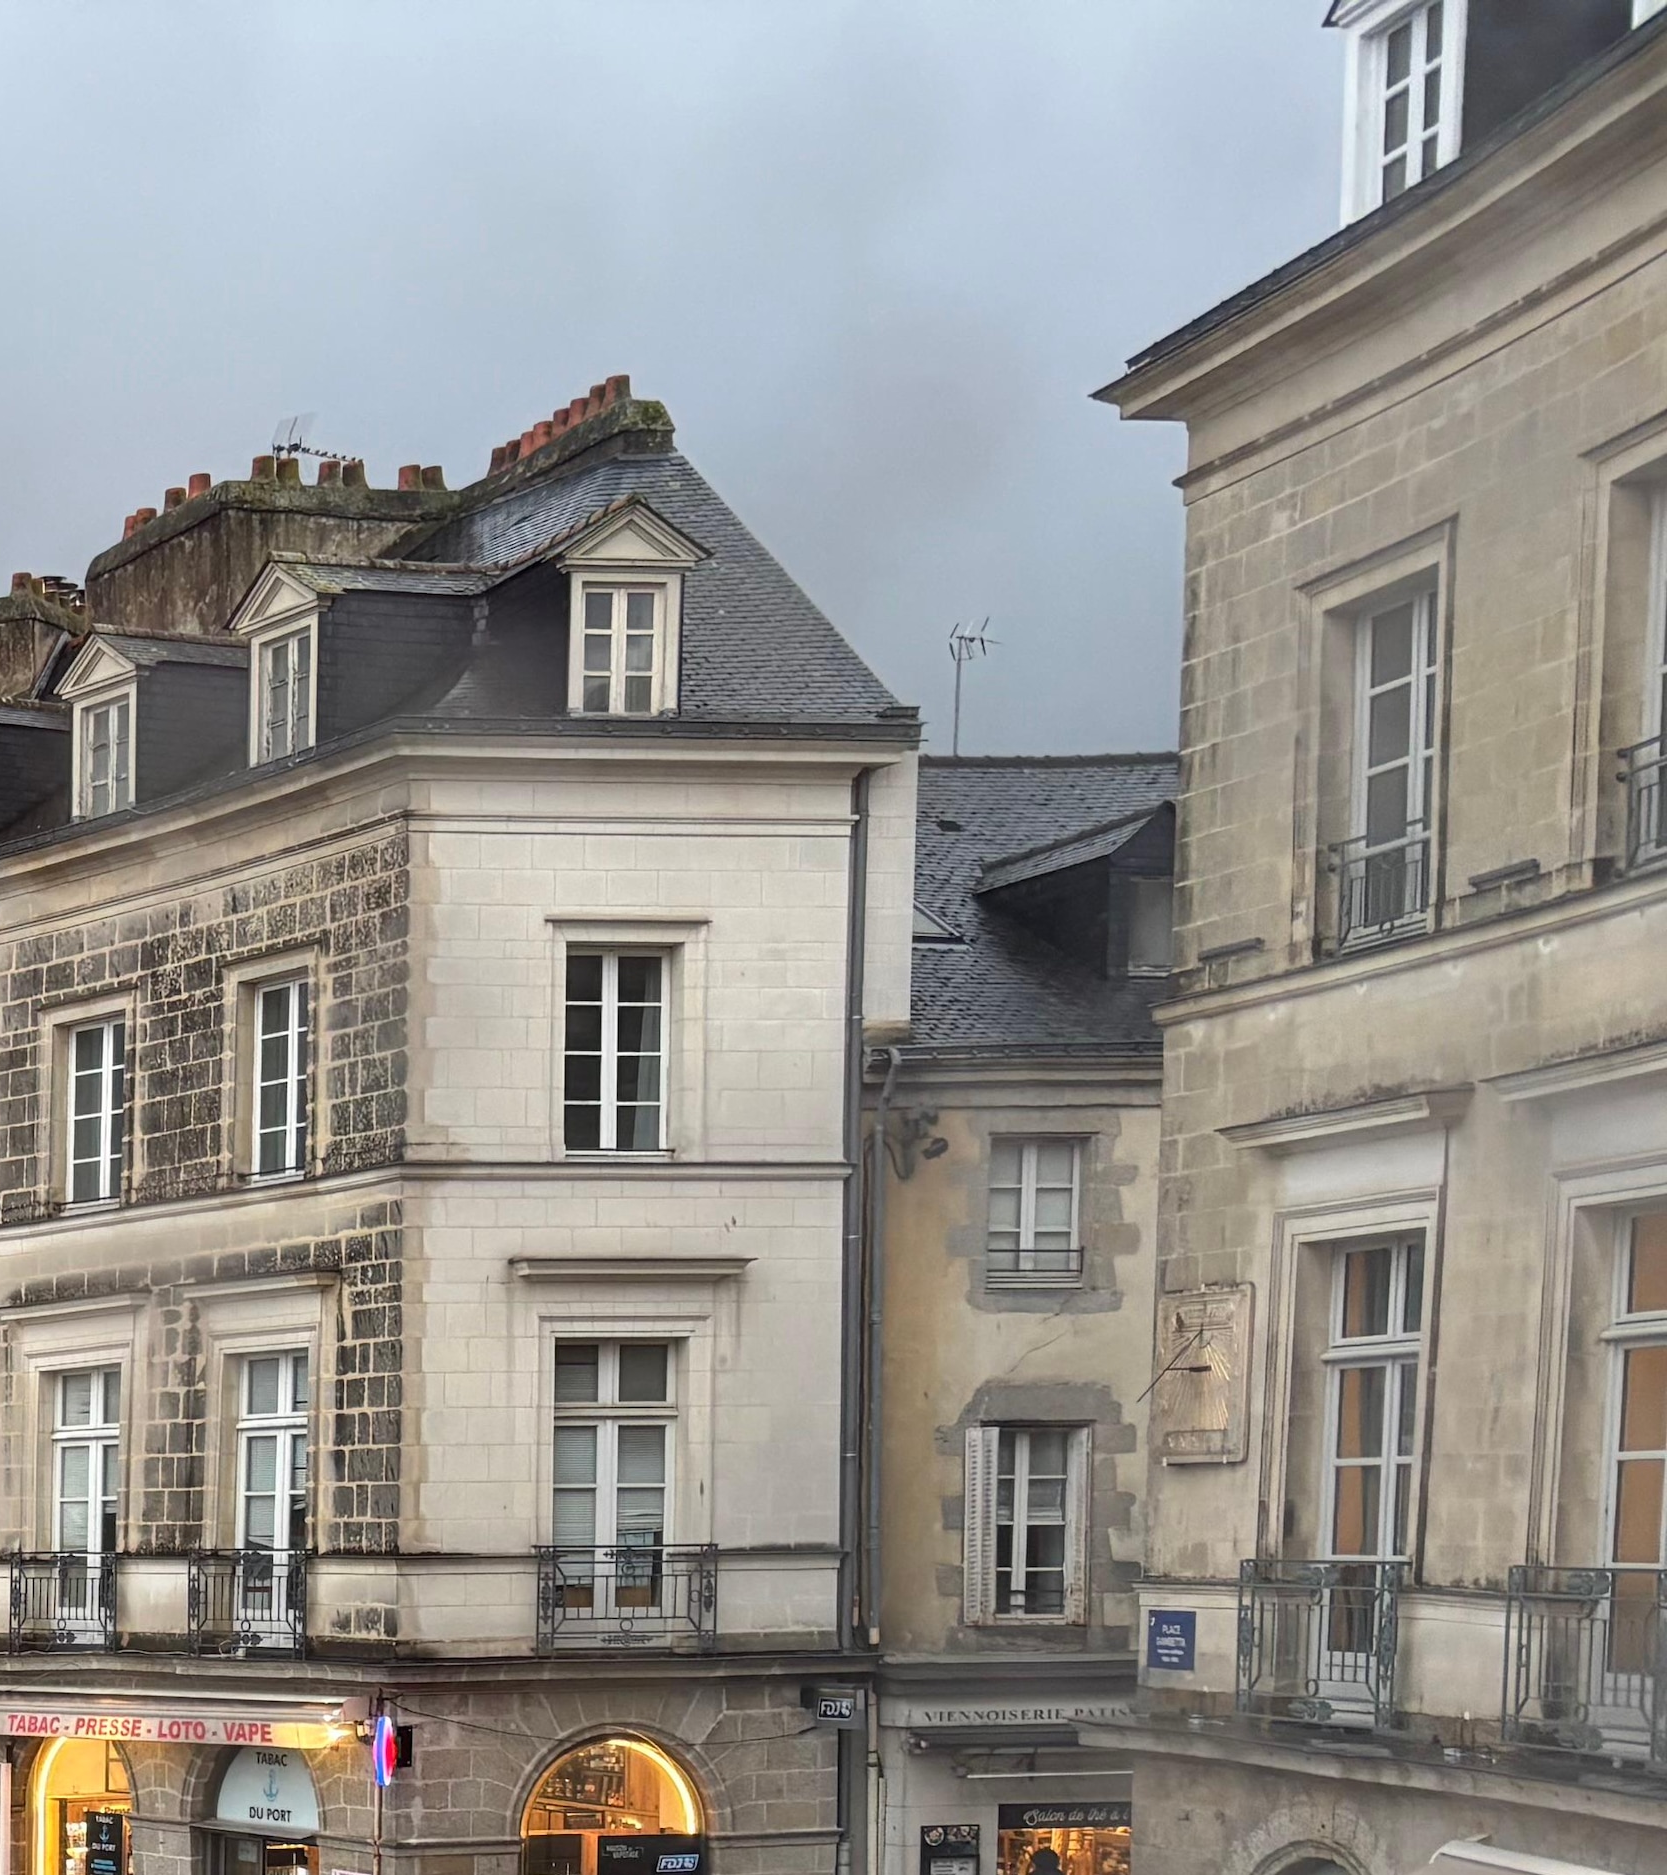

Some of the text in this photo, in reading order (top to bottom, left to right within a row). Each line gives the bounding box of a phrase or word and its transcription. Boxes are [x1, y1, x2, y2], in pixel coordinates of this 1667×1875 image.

[820, 1701, 841, 1716] FDJ
[924, 1707, 1129, 1723] VIENNOISERIE PATIS
[8, 1714, 273, 1743] TABAC PRESSE LOTO VAPE
[256, 1752, 288, 1767] TABAC
[249, 1806, 292, 1823] DU PORT
[1023, 1808, 1065, 1826] Salon
[660, 1857, 683, 1869] FDJ
